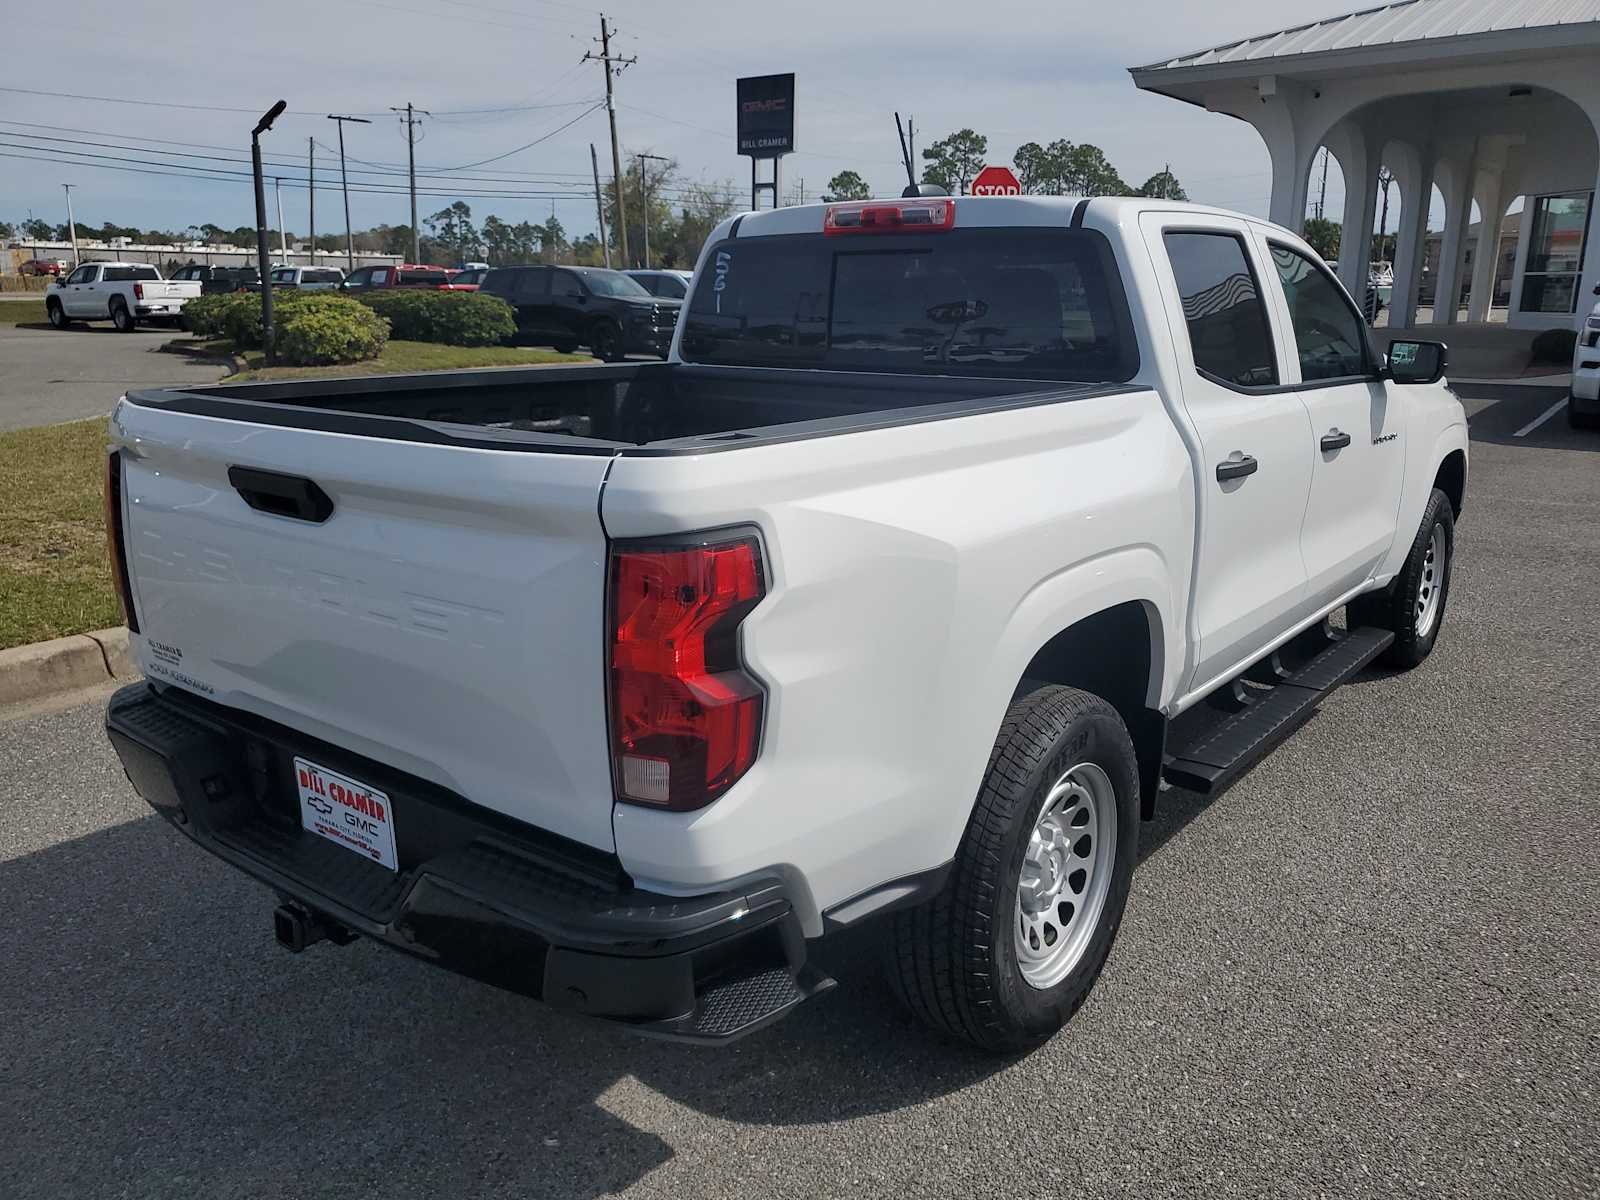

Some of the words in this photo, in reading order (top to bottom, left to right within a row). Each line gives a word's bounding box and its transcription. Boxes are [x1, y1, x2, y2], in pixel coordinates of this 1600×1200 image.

[743, 99, 785, 112] GMC
[742, 140, 756, 149] BILL
[759, 137, 787, 147] CRAMER
[299, 768, 326, 796] BILL
[329, 782, 386, 823] CRAMER
[344, 812, 379, 837] GMC
